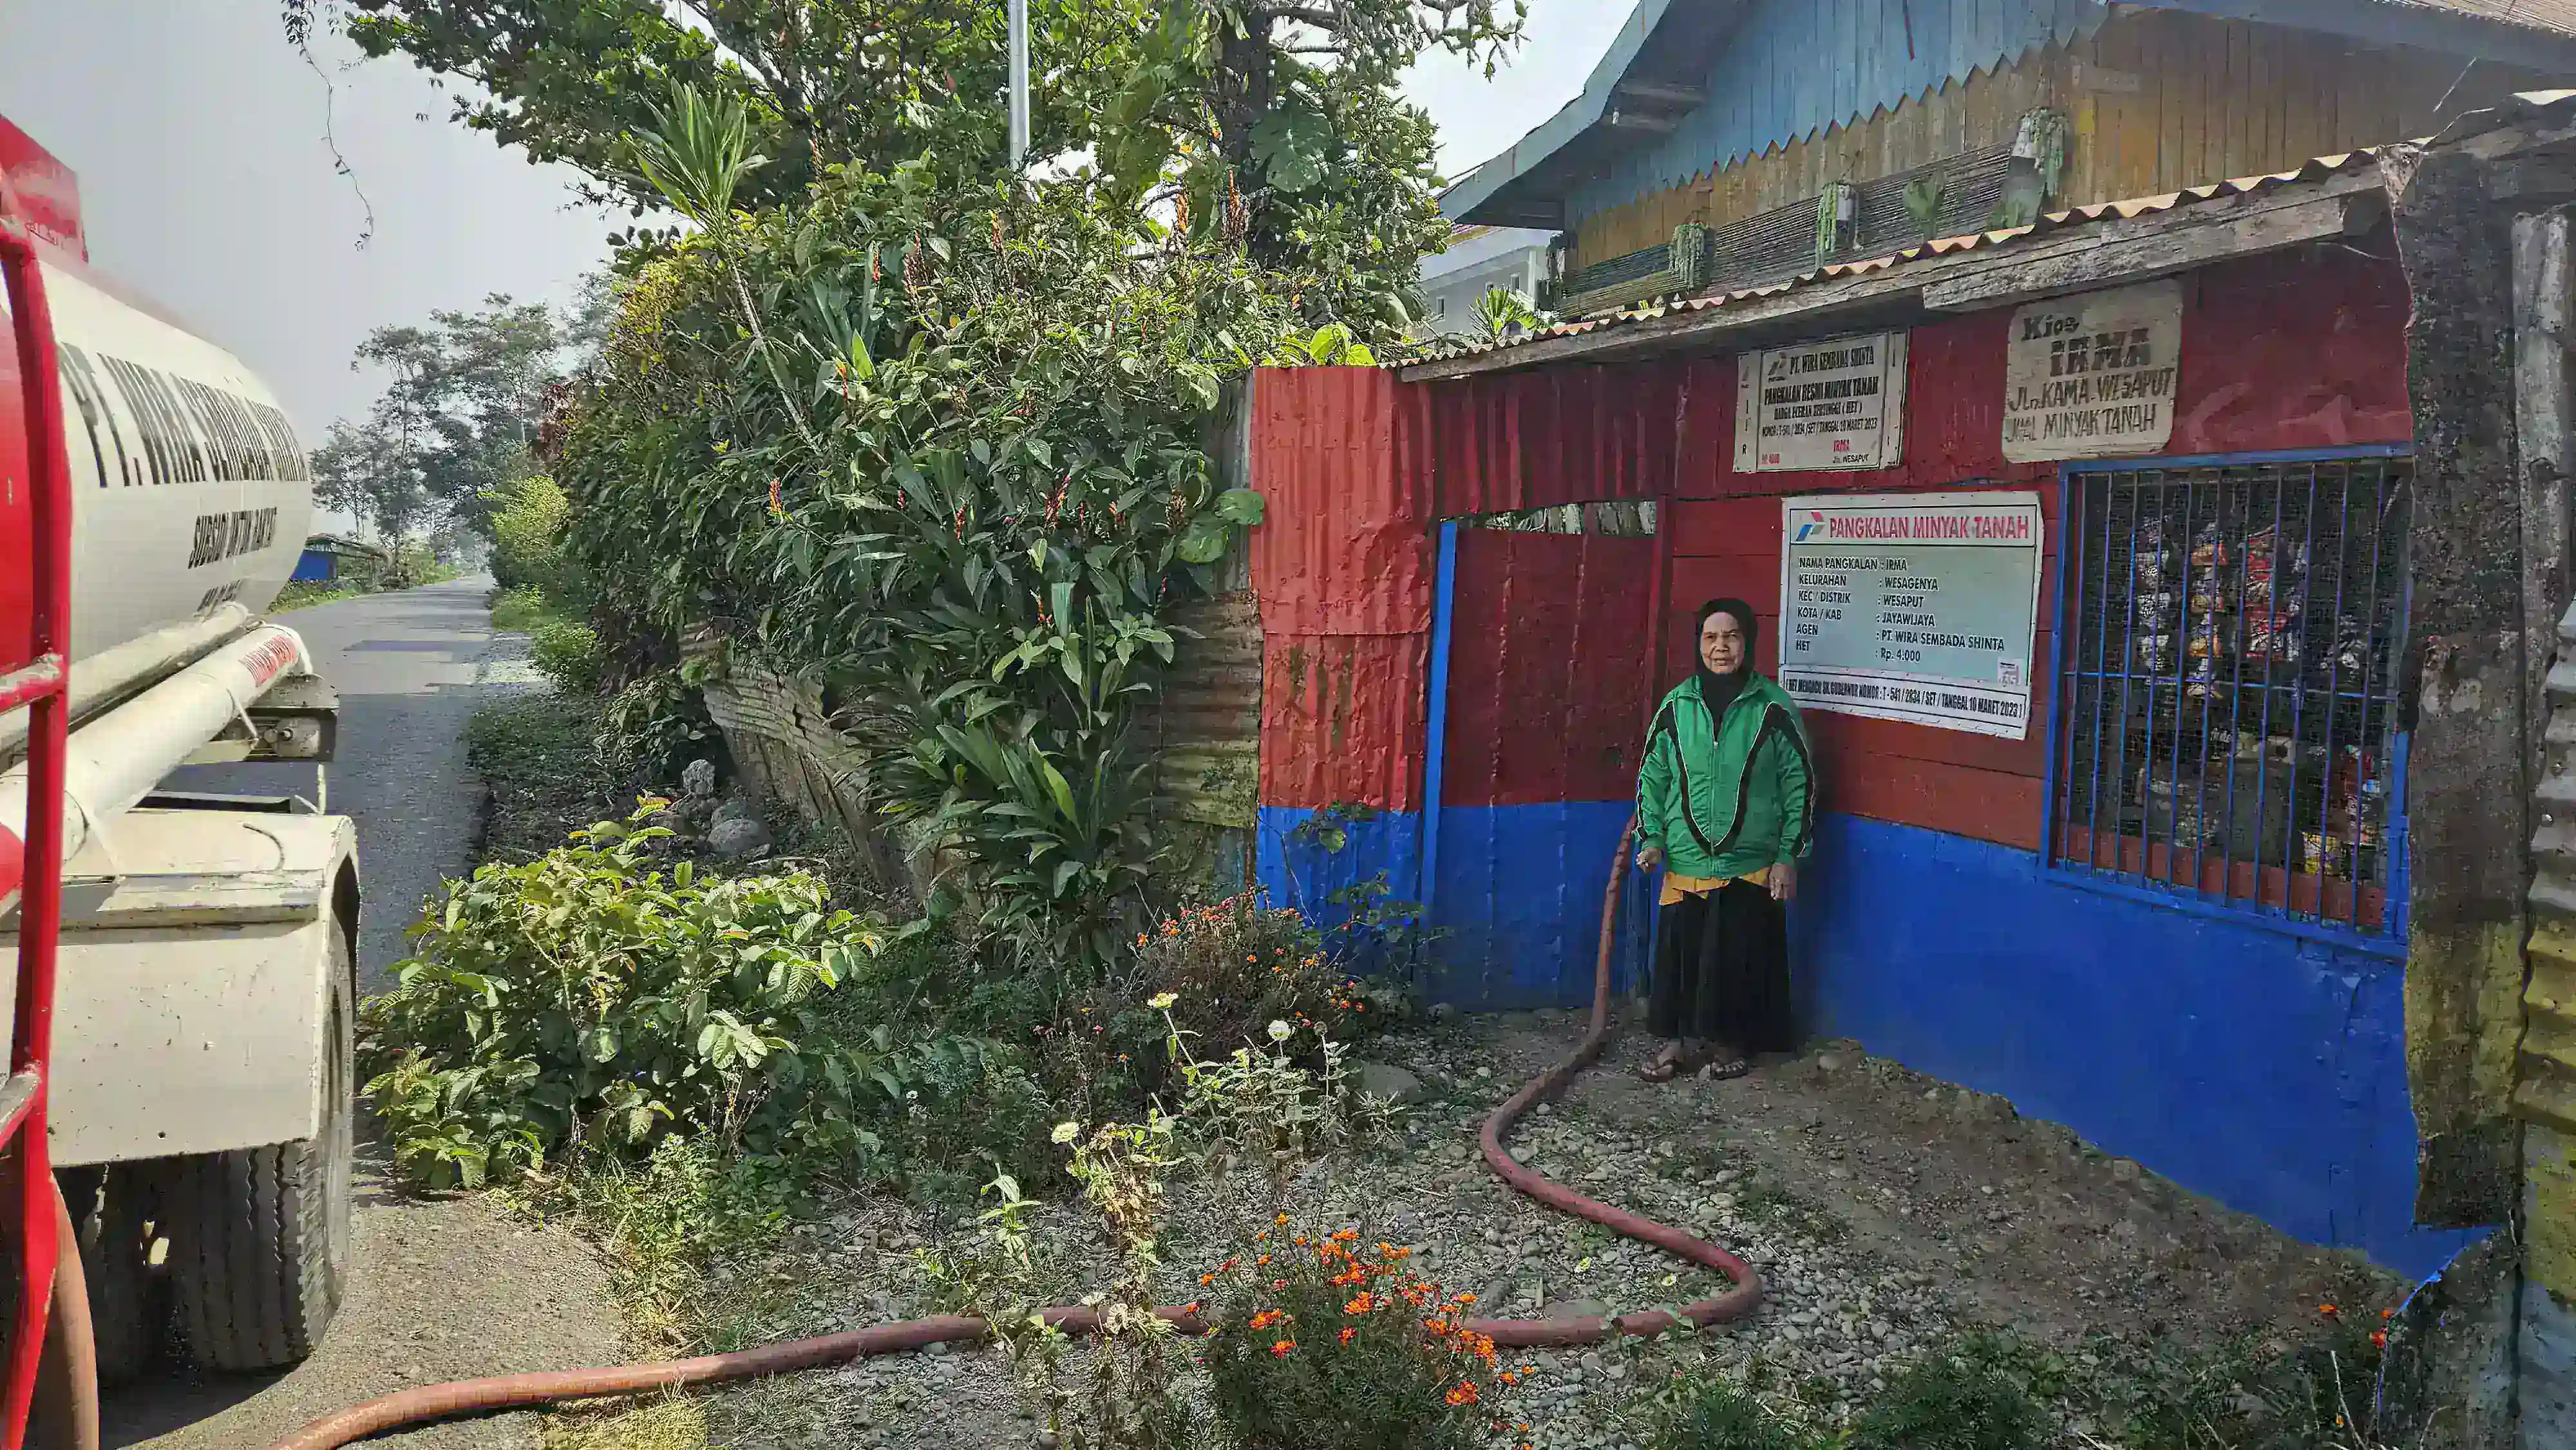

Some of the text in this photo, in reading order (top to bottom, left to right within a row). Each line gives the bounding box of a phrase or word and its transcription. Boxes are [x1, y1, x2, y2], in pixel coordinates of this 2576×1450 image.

[2022, 314, 2079, 341] Kios
[1764, 384, 1801, 406] PANGKALAN
[1853, 376, 1879, 396] TANAH
[2097, 368, 2176, 401] WESAPUT
[2043, 409, 2100, 439] MINYAK
[2103, 404, 2157, 435] TANAH
[1829, 516, 2029, 539] PANGKALAN MINYAK TANAH
[1799, 557, 1823, 569] NAMA
[1826, 558, 1877, 570] PANGKALAN
[1886, 558, 1908, 570] IRMA
[1799, 574, 1846, 586] KELURAHAN
[1884, 577, 1938, 590] WESAGENYA
[1799, 590, 1813, 602] KEC
[1820, 592, 1851, 603] DISTRIK
[1883, 595, 1924, 607] WESAPUT
[1797, 607, 1818, 618] KOTA
[1826, 608, 1842, 620] KAB
[1882, 612, 1936, 627] JAYAWIJAYA
[1796, 624, 1819, 636] AGEN
[1882, 630, 1893, 641] PT.
[1895, 631, 1918, 643] WIRA
[1920, 632, 1966, 648] SEMBADA
[1968, 636, 2005, 651] SHINTA
[1795, 640, 1810, 651] HET
[1880, 648, 1894, 661] Rp.
[1859, 684, 1879, 699] NOMOR
[1926, 691, 1937, 706] SET
[1942, 693, 1968, 710] TANGGAL
[1969, 697, 1976, 711] 10
[1978, 697, 2000, 715] MARET
